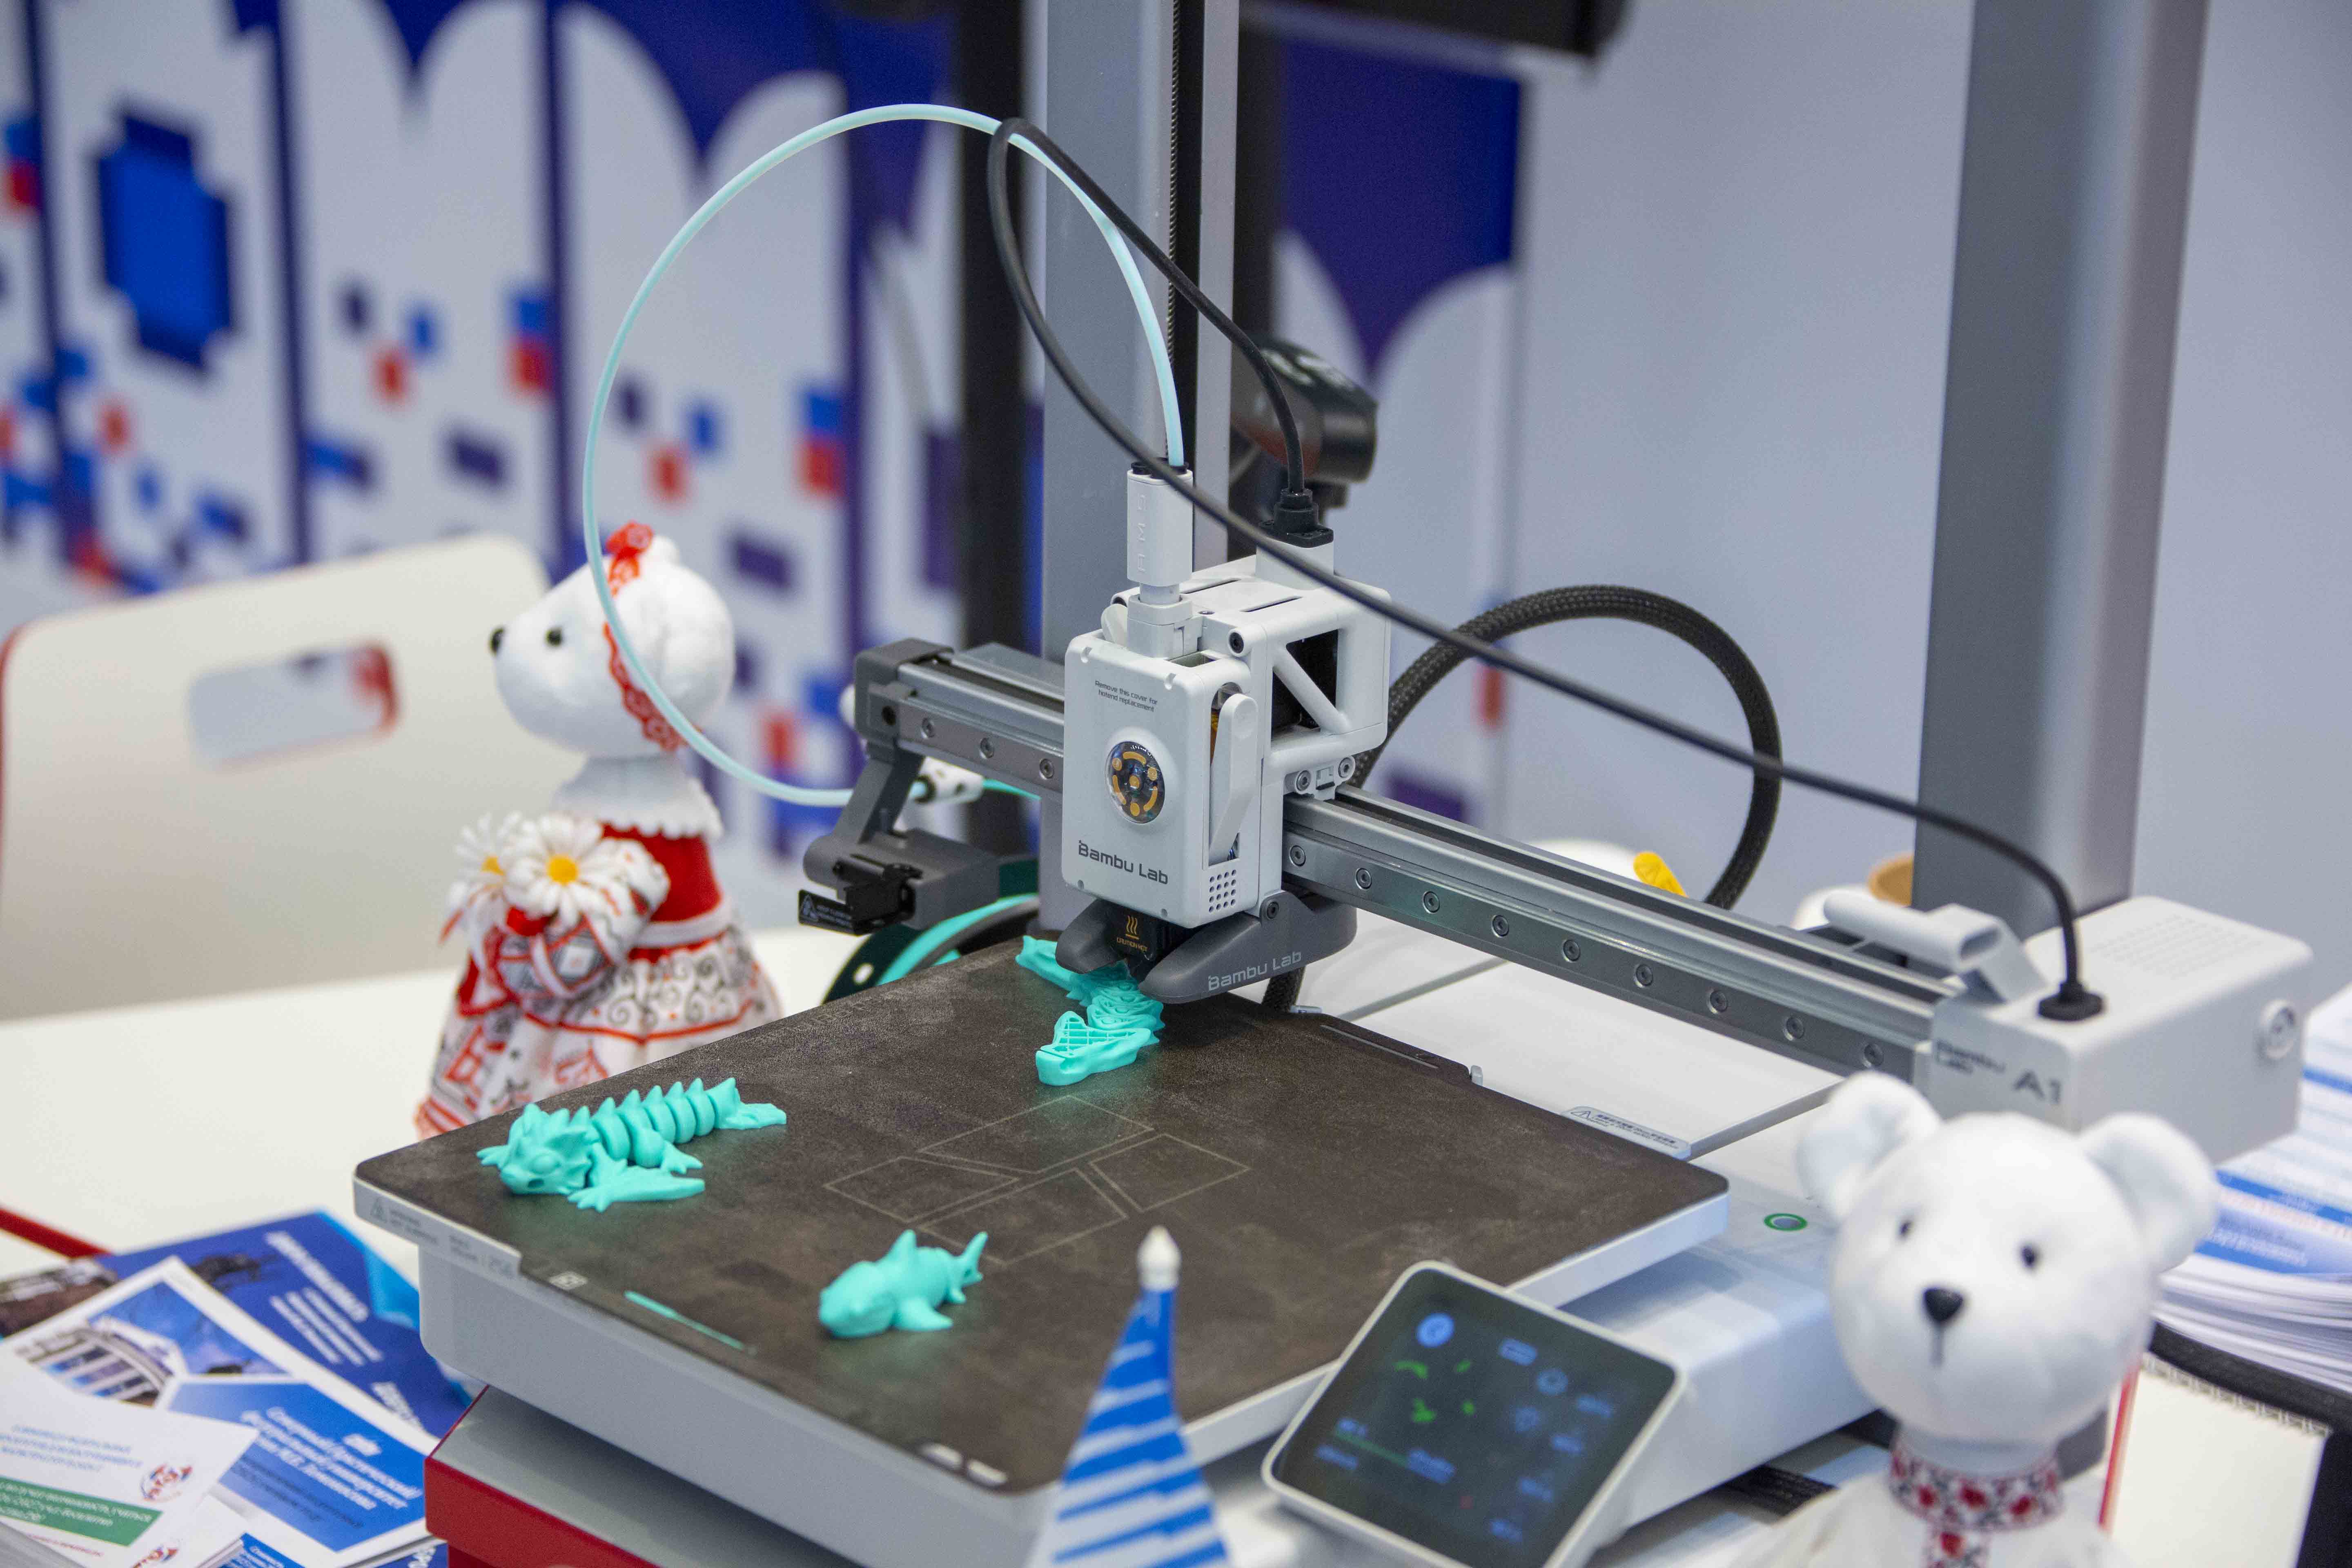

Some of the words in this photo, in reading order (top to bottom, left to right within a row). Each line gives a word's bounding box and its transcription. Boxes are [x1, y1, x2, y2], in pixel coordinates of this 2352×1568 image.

[1095, 680, 1118, 693] Remove
[1119, 688, 1130, 696] this
[1131, 693, 1147, 702] cover
[1098, 689, 1118, 701] hotend
[1119, 696, 1154, 712] replacement
[1078, 840, 1134, 873] Bambu
[1139, 863, 1168, 884] Lab
[1117, 937, 1137, 948] CAUTION
[1208, 963, 1267, 991] Bambu
[1272, 951, 1301, 971] Lab
[2012, 1068, 2060, 1104] A1
